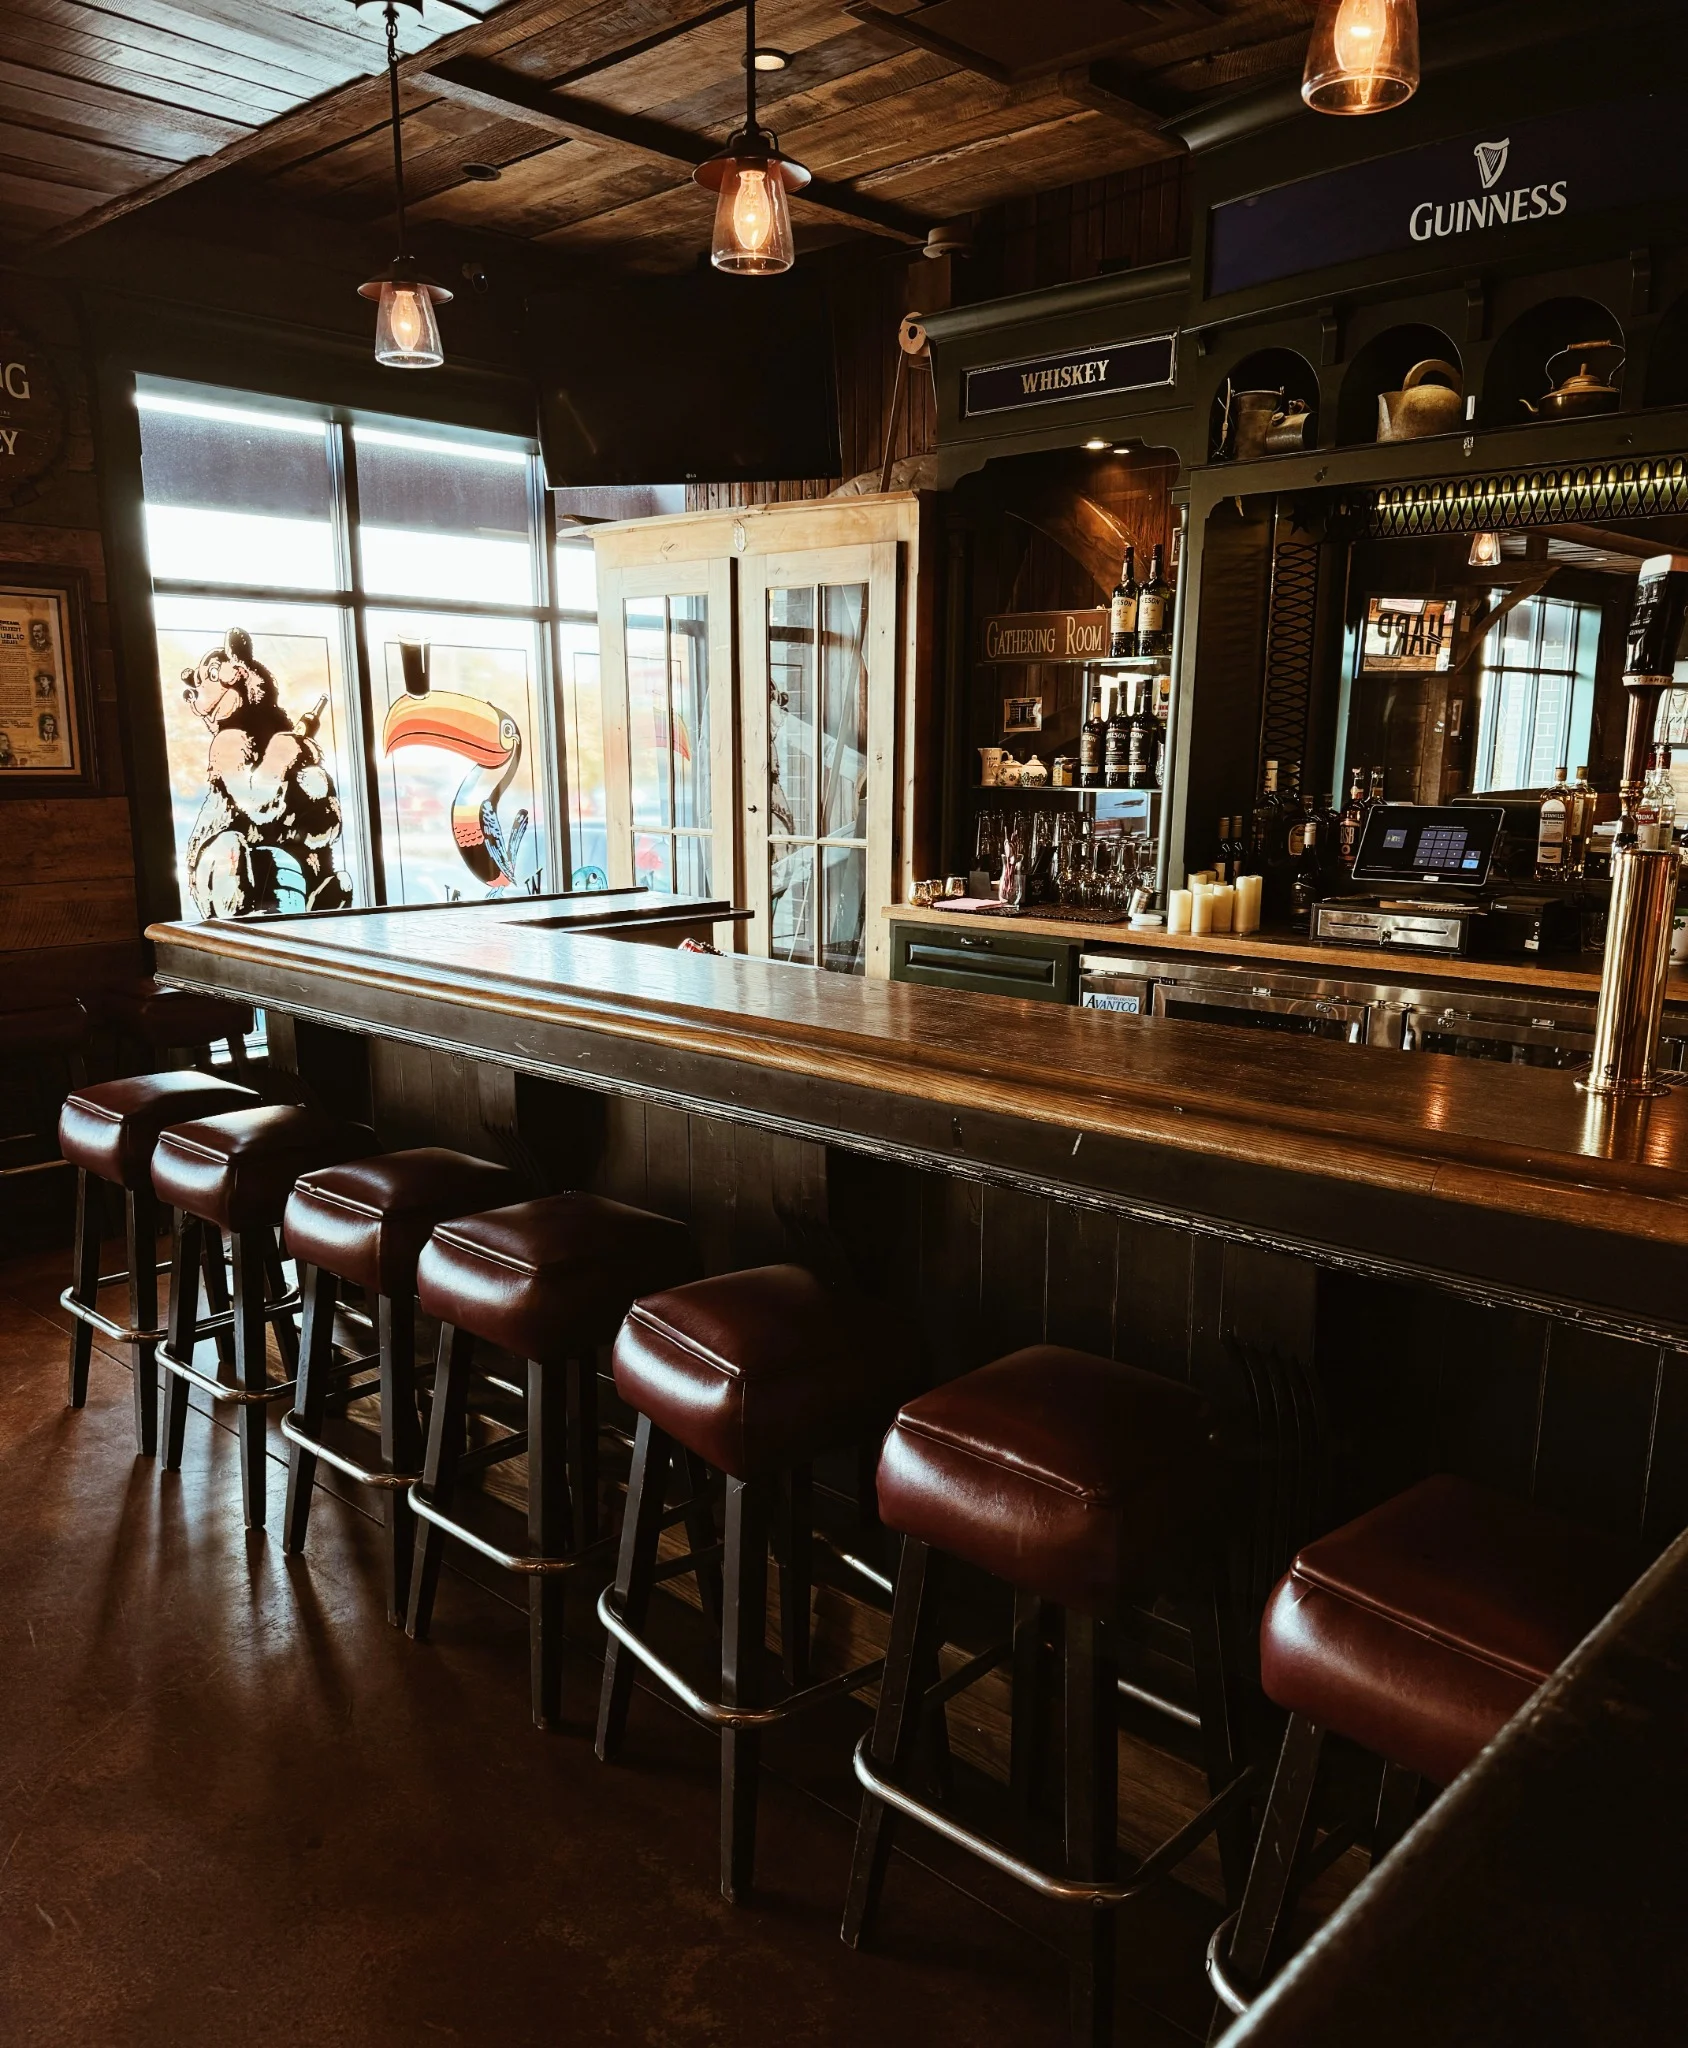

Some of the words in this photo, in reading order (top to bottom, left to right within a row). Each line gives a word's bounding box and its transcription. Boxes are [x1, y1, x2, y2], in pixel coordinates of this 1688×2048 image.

[1409, 181, 1567, 241] GUINNESS
[1021, 360, 1109, 393] WHISKEY
[987, 621, 1056, 658] GATHERING
[1065, 616, 1103, 654] ROOM
[1085, 995, 1137, 1012] AVANTCO
